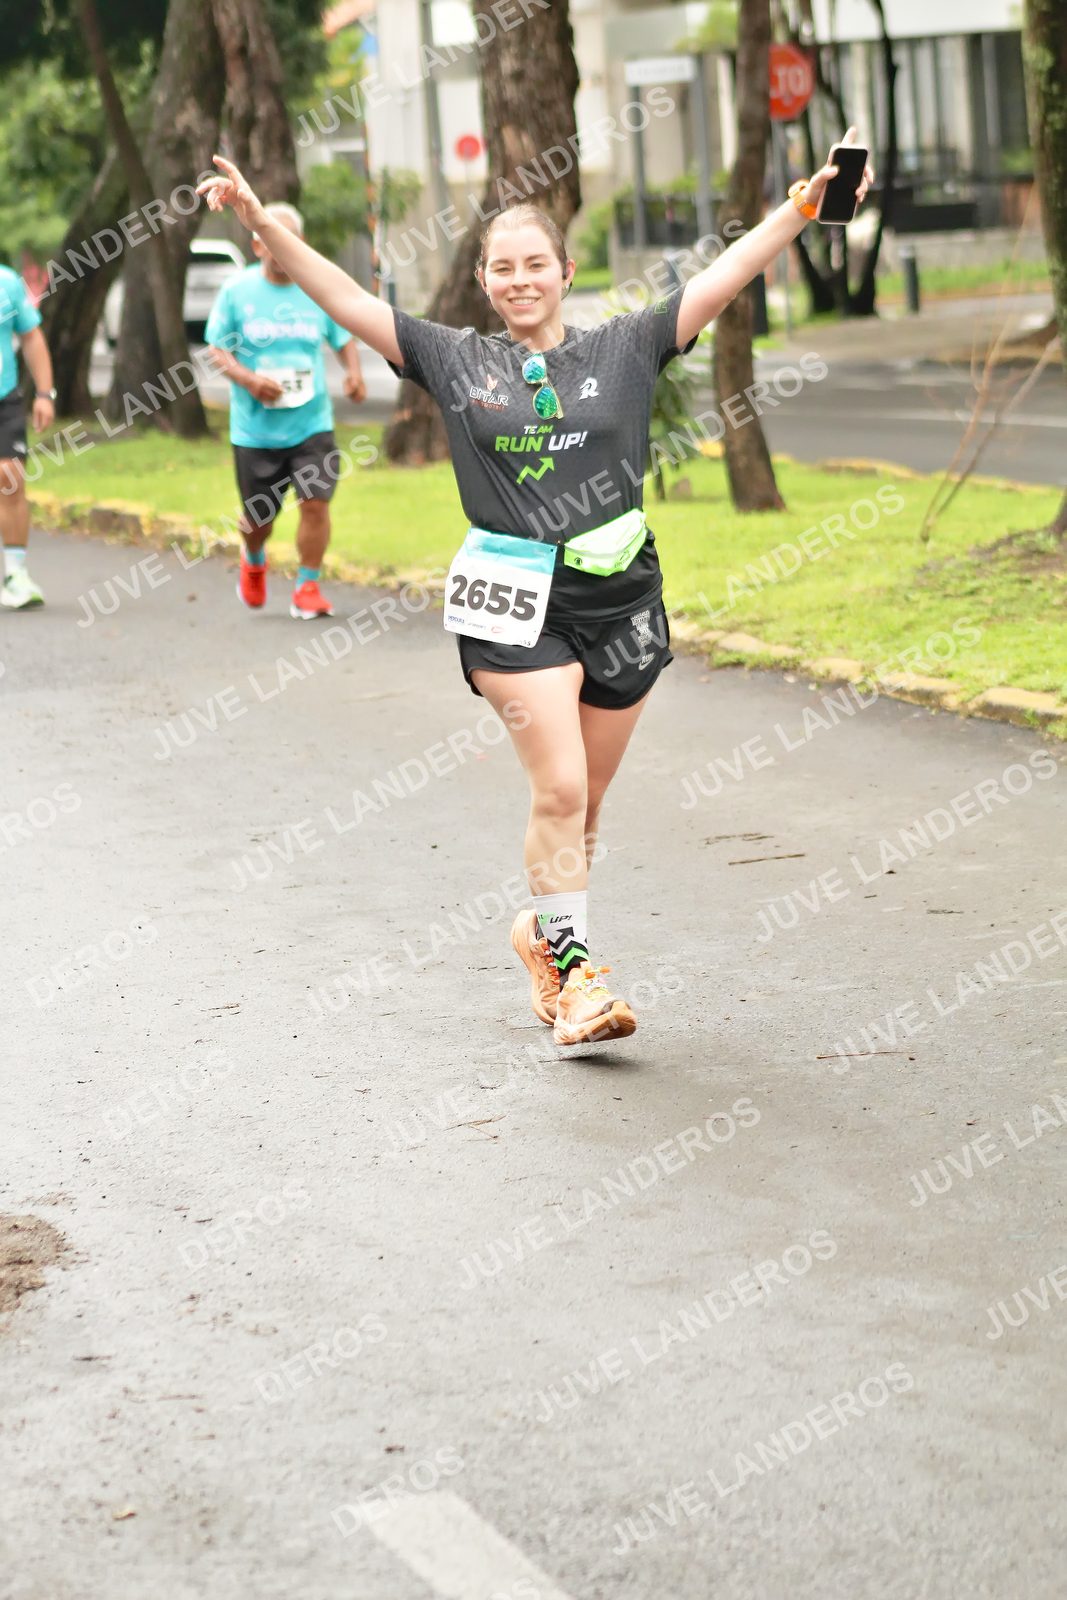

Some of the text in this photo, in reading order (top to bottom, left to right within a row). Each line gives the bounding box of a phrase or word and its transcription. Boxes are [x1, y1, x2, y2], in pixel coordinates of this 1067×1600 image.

[469, 386, 508, 406] BITAR
[523, 425, 554, 435] TEAM
[495, 431, 588, 452] RUN UP!
[450, 574, 538, 621] 2655
